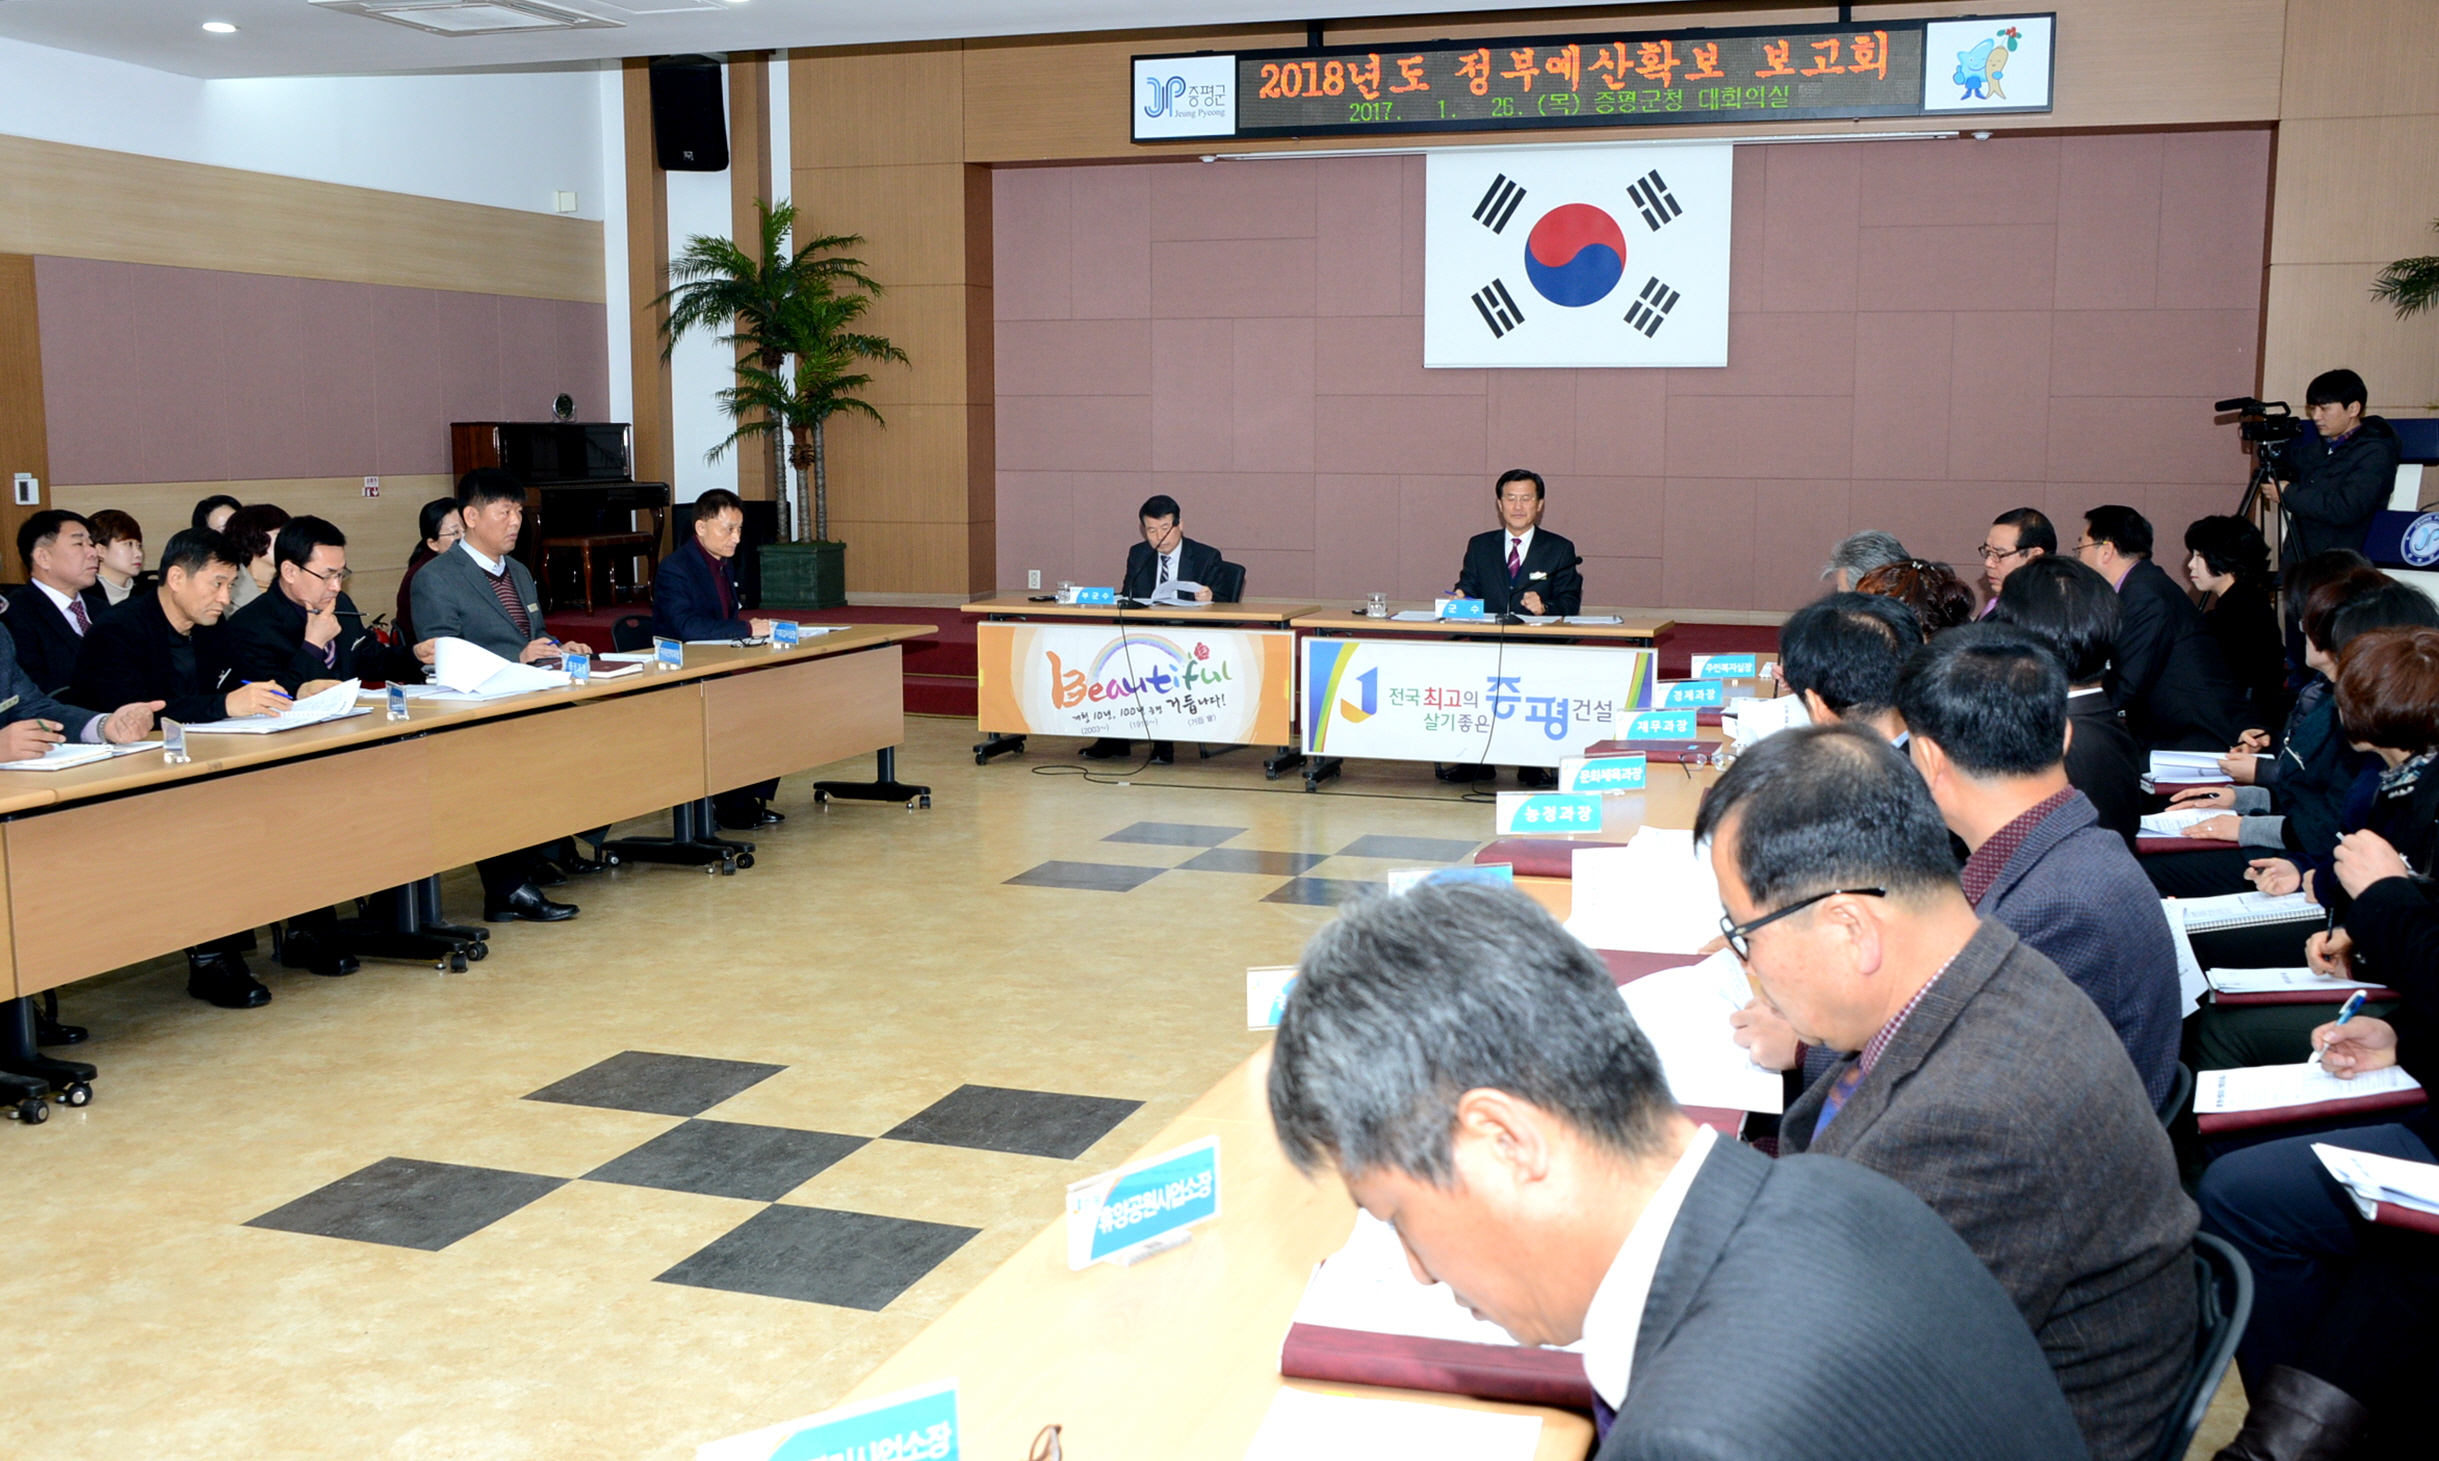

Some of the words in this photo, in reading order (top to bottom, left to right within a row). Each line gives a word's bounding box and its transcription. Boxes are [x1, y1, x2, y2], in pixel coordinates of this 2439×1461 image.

[1259, 53, 1430, 100] 2018년도
[1455, 39, 1725, 96] 정부예산확보
[1755, 30, 1888, 80] 보고회
[1188, 84, 1226, 108] 증평군
[1349, 102, 1402, 121] 2017.
[1438, 100, 1456, 118] 1.
[1491, 97, 1523, 116] 26.
[1537, 93, 1581, 116] (목)
[1595, 88, 1683, 114] 증평군청
[1699, 85, 1790, 110] 대회의실
[1174, 109, 1196, 119] Jeung
[1197, 108, 1226, 118] Pyeong
[1046, 651, 1232, 710] Beautiful
[1673, 688, 1716, 702] 경제과장
[1572, 699, 1612, 723] 건설
[1637, 719, 1689, 734] 재무과장
[1525, 805, 1593, 822] 농정과장
[1098, 1169, 1213, 1235] 휴양공원사업소장
